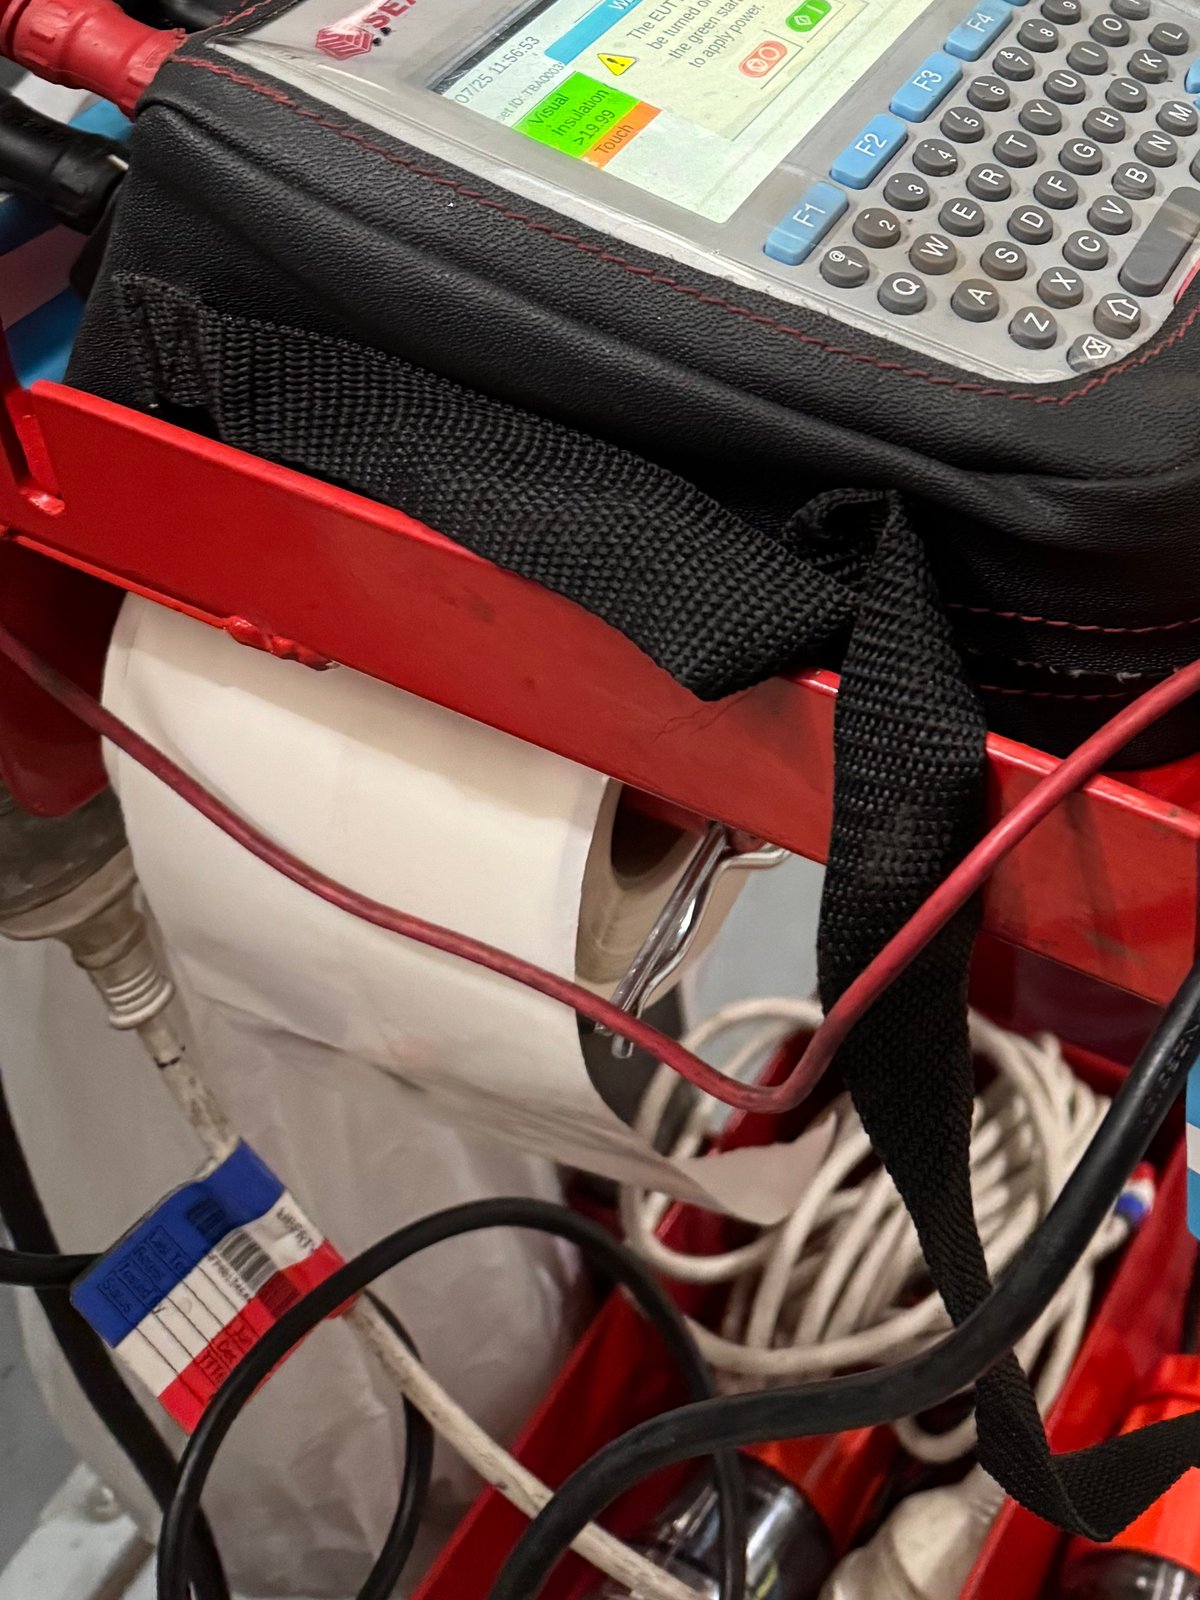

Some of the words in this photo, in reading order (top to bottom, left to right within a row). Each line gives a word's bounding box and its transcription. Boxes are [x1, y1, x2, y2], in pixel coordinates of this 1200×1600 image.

[1062, 0, 1078, 10] 9
[626, 21, 655, 39] The
[648, 0, 678, 22] EUT
[646, 36, 669, 50] be
[662, 5, 702, 37] turned
[966, 11, 995, 33] F4
[1102, 18, 1122, 32] O
[668, 43, 692, 59] the
[688, 16, 721, 45] green
[688, 57, 706, 68] to
[702, 31, 735, 58] apply
[729, 4, 765, 34] power.
[1039, 28, 1055, 38] 8
[1161, 29, 1182, 40] L
[488, 36, 540, 75] 11:56:53
[1080, 46, 1100, 58] I
[1014, 56, 1030, 66] 7
[1140, 53, 1162, 69] K
[912, 70, 943, 92] F3
[1054, 72, 1078, 89] U
[1121, 82, 1140, 96] J
[990, 85, 1006, 96] 6
[529, 93, 570, 124] Visual
[551, 89, 610, 136] Insulation
[1030, 102, 1053, 117] Y
[1168, 104, 1193, 122] M
[963, 116, 980, 130] 5
[1095, 110, 1120, 128] H
[594, 123, 634, 154] Touch
[854, 133, 888, 158] F2
[1004, 134, 1028, 148] T
[1148, 134, 1172, 151] N
[1072, 142, 1096, 158] G
[978, 168, 1004, 186] R
[1046, 175, 1068, 192] F
[1124, 167, 1148, 184] B
[907, 184, 924, 196] 3
[792, 202, 827, 228] F1
[951, 202, 977, 220] E
[1100, 200, 1124, 216] V
[878, 218, 896, 232] 2
[1020, 210, 1044, 229] D
[920, 236, 950, 258] W
[1077, 236, 1101, 252] C
[847, 258, 864, 269] 1
[995, 247, 1019, 264] S
[892, 277, 921, 296] Q
[1050, 272, 1077, 291] X
[967, 287, 992, 306] A
[1024, 312, 1050, 332] Z
